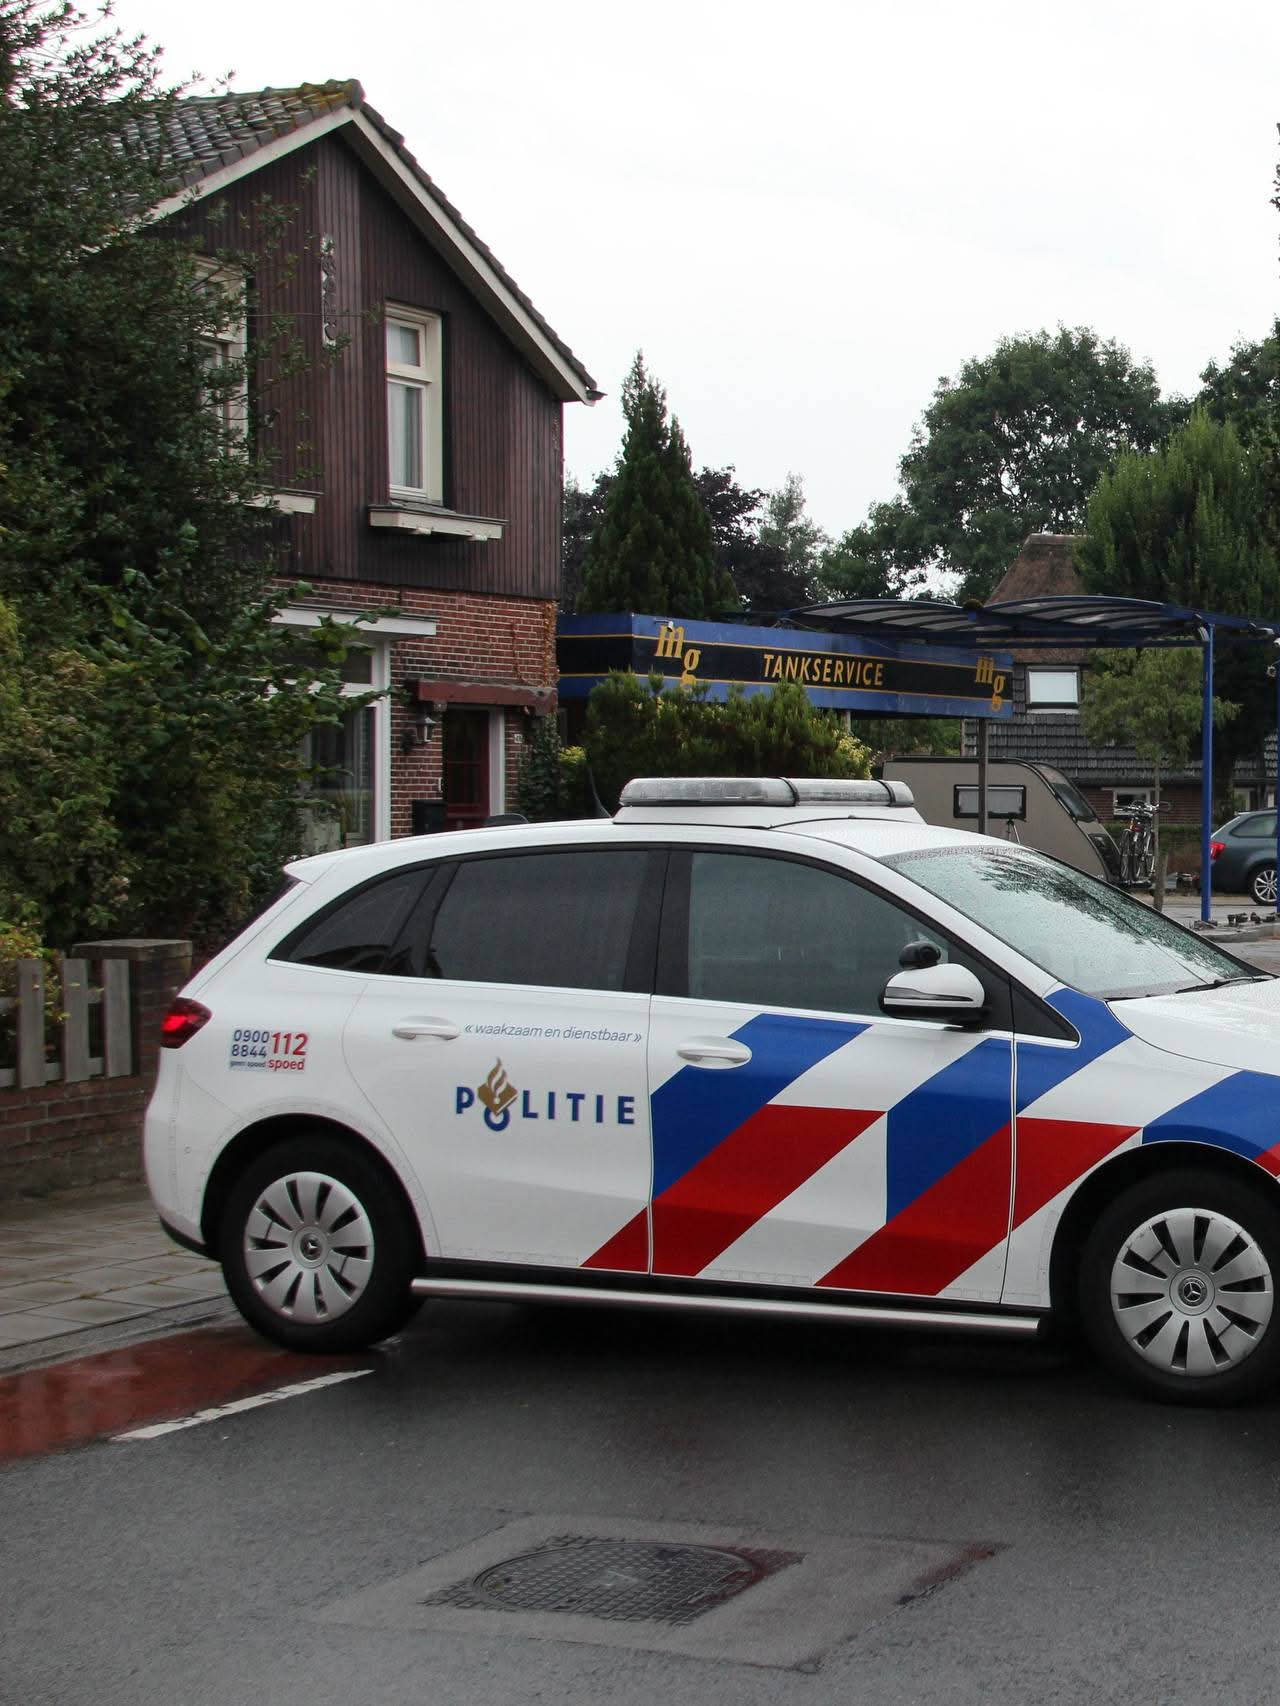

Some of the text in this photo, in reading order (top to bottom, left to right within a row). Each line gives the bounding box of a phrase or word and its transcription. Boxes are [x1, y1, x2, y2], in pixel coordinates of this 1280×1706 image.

[763, 653, 883, 686] TANKSERVICE
[234, 1029, 270, 1043] 0900
[475, 1023, 543, 1037] waakzaam
[544, 1027, 561, 1039] en
[563, 1026, 632, 1042] dienstbaar
[231, 1044, 267, 1057] 8844
[272, 1032, 309, 1056] 112
[268, 1058, 306, 1071] spoed
[456, 1086, 635, 1132] POLITIE
